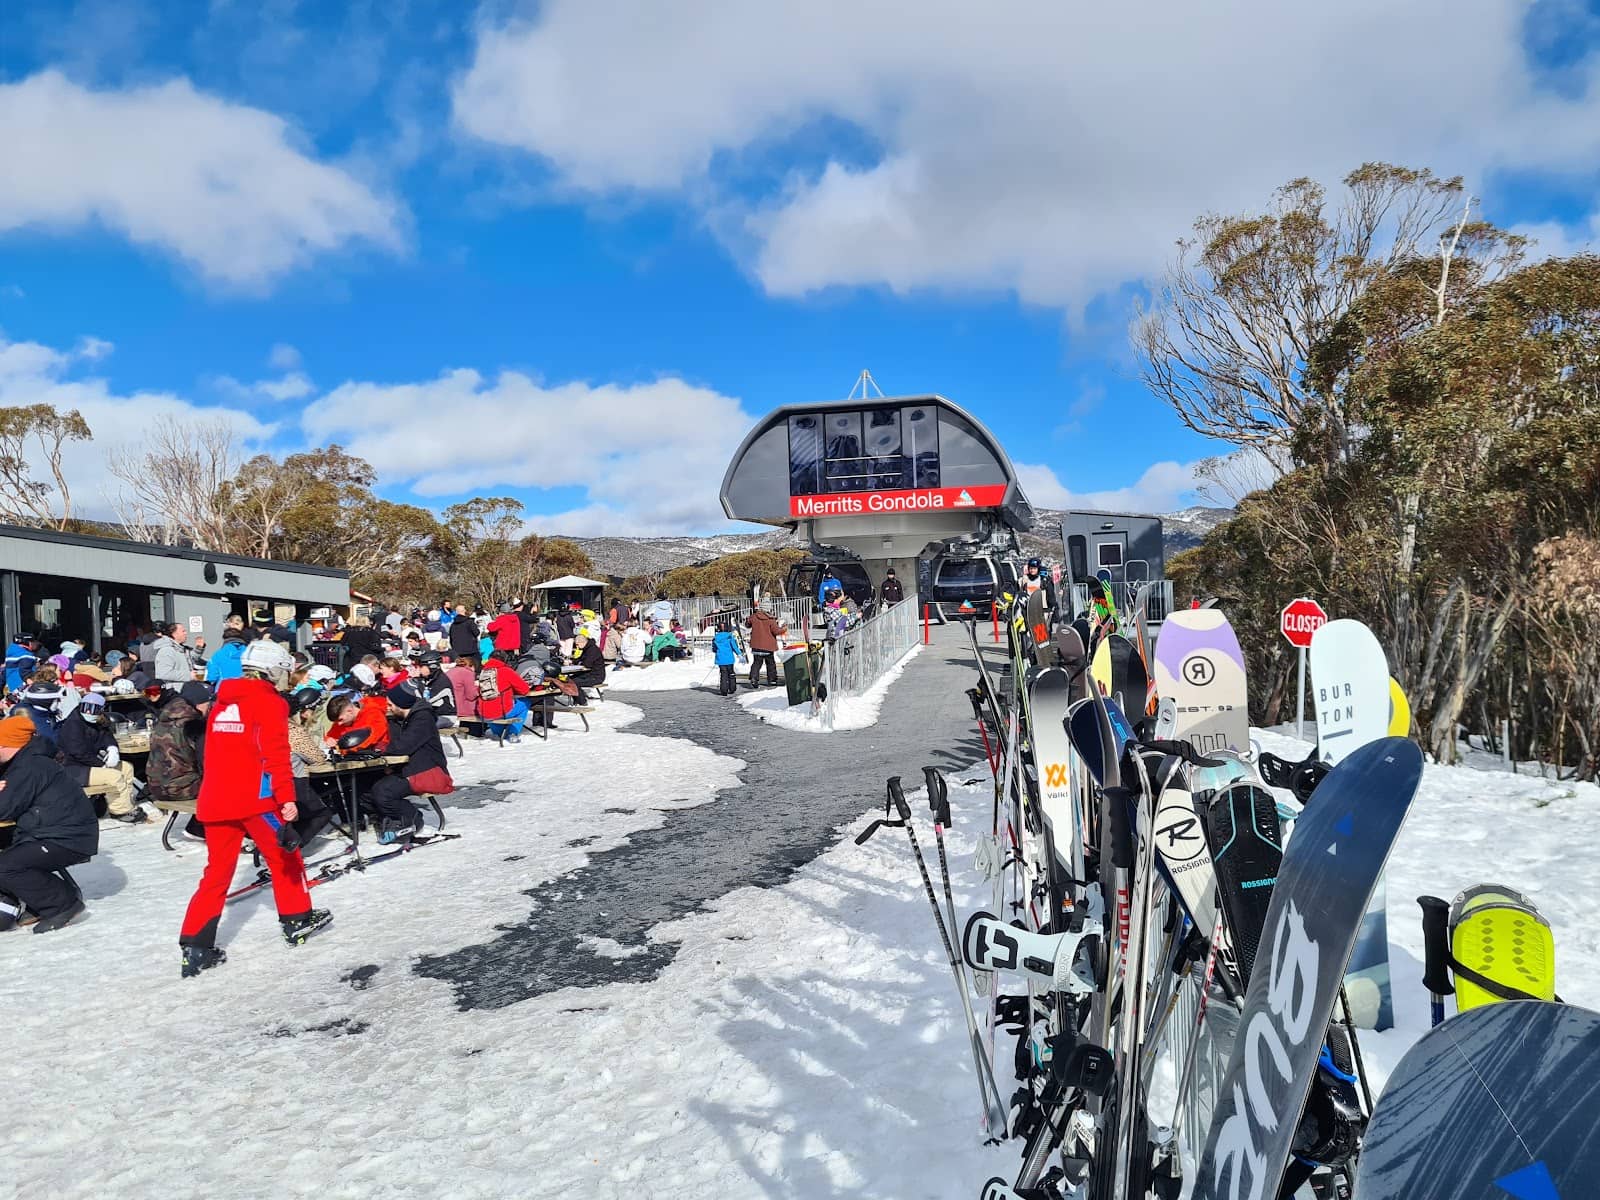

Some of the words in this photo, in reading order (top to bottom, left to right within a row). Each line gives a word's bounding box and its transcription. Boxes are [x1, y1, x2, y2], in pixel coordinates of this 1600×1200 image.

[797, 496, 863, 515] Merritts
[868, 491, 944, 511] Gondola
[1284, 612, 1325, 633] CLOSED
[1320, 683, 1352, 702] BUR
[1322, 706, 1353, 725] TON
